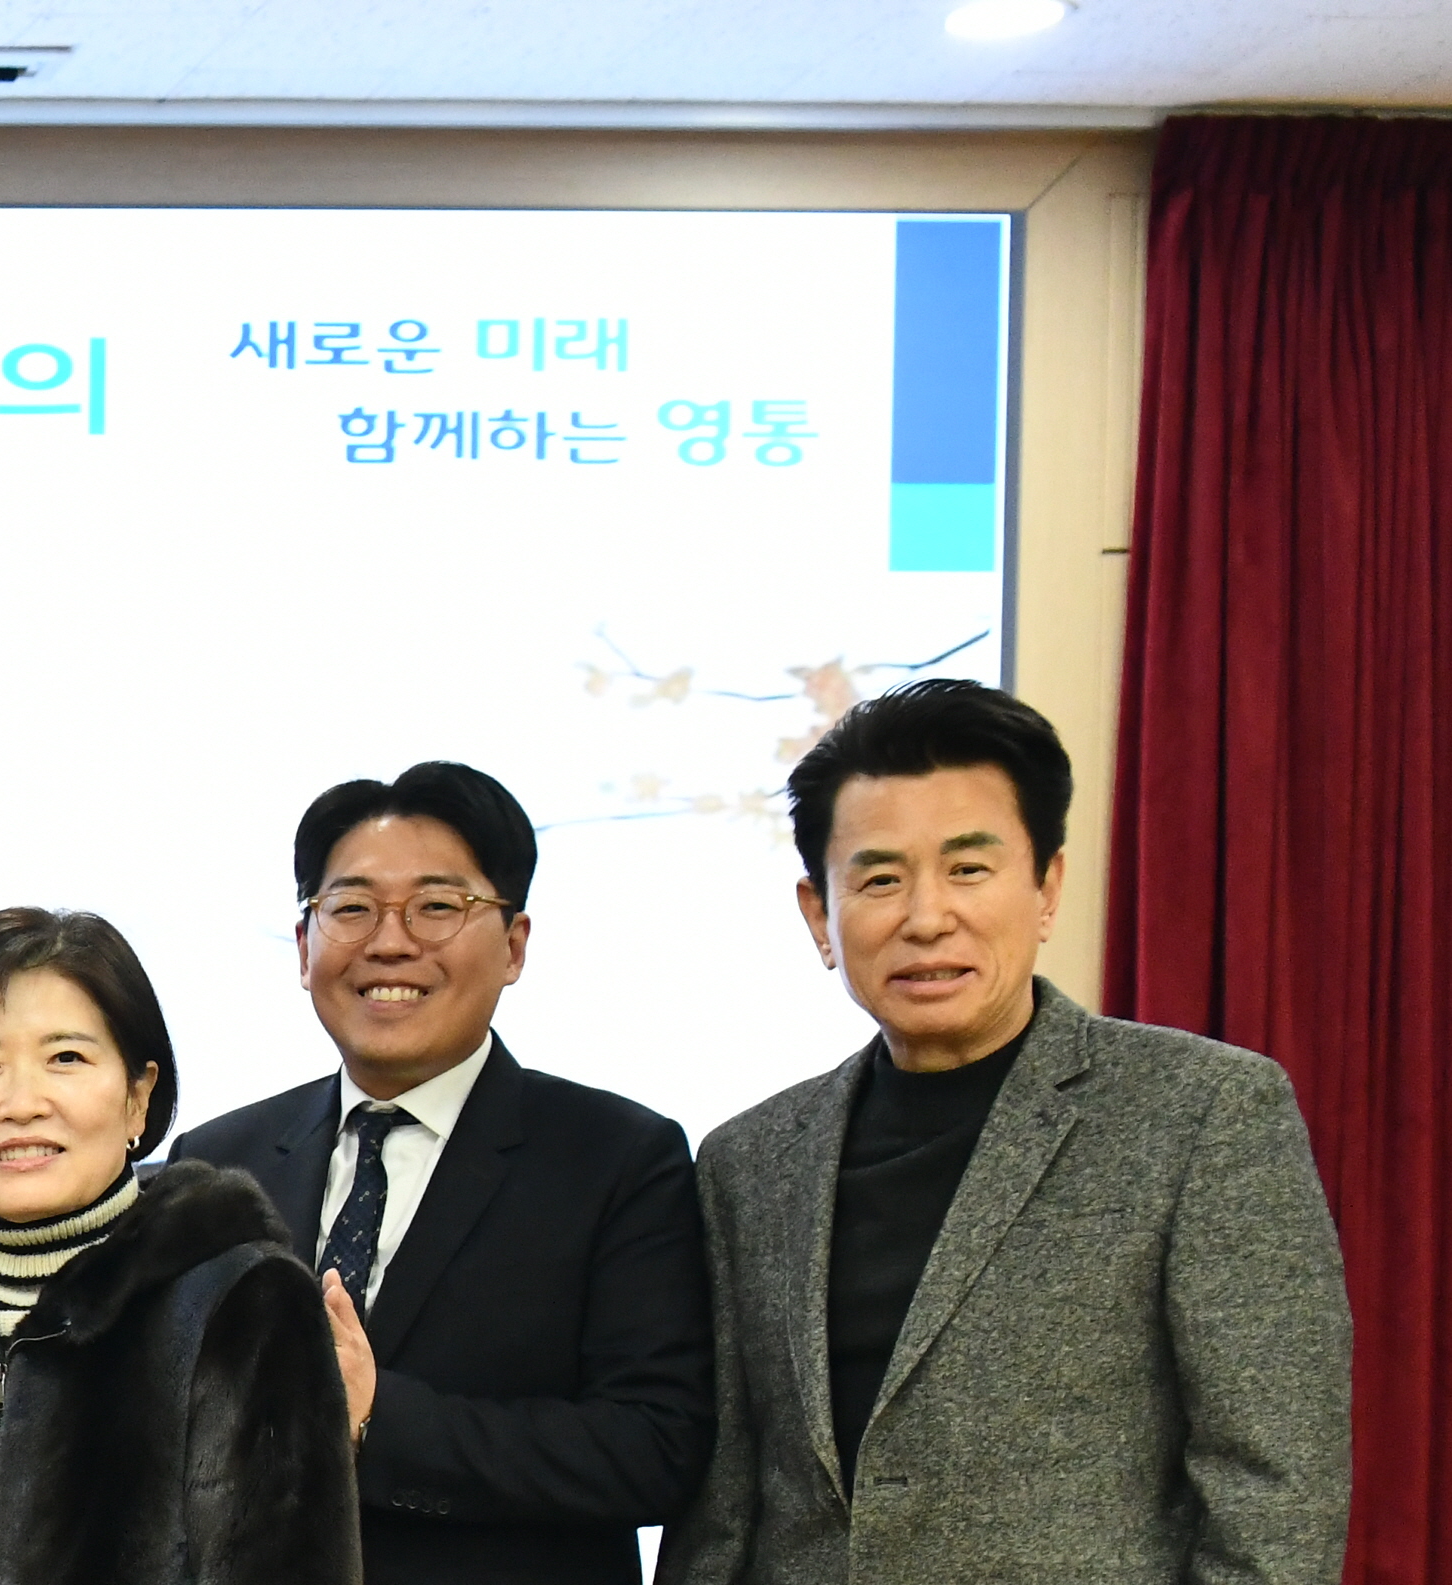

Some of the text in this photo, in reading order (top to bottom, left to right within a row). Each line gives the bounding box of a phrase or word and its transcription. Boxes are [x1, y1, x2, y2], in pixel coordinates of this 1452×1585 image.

[229, 317, 628, 375] 새로운 미래
[338, 400, 818, 467] 함께하는 영통
